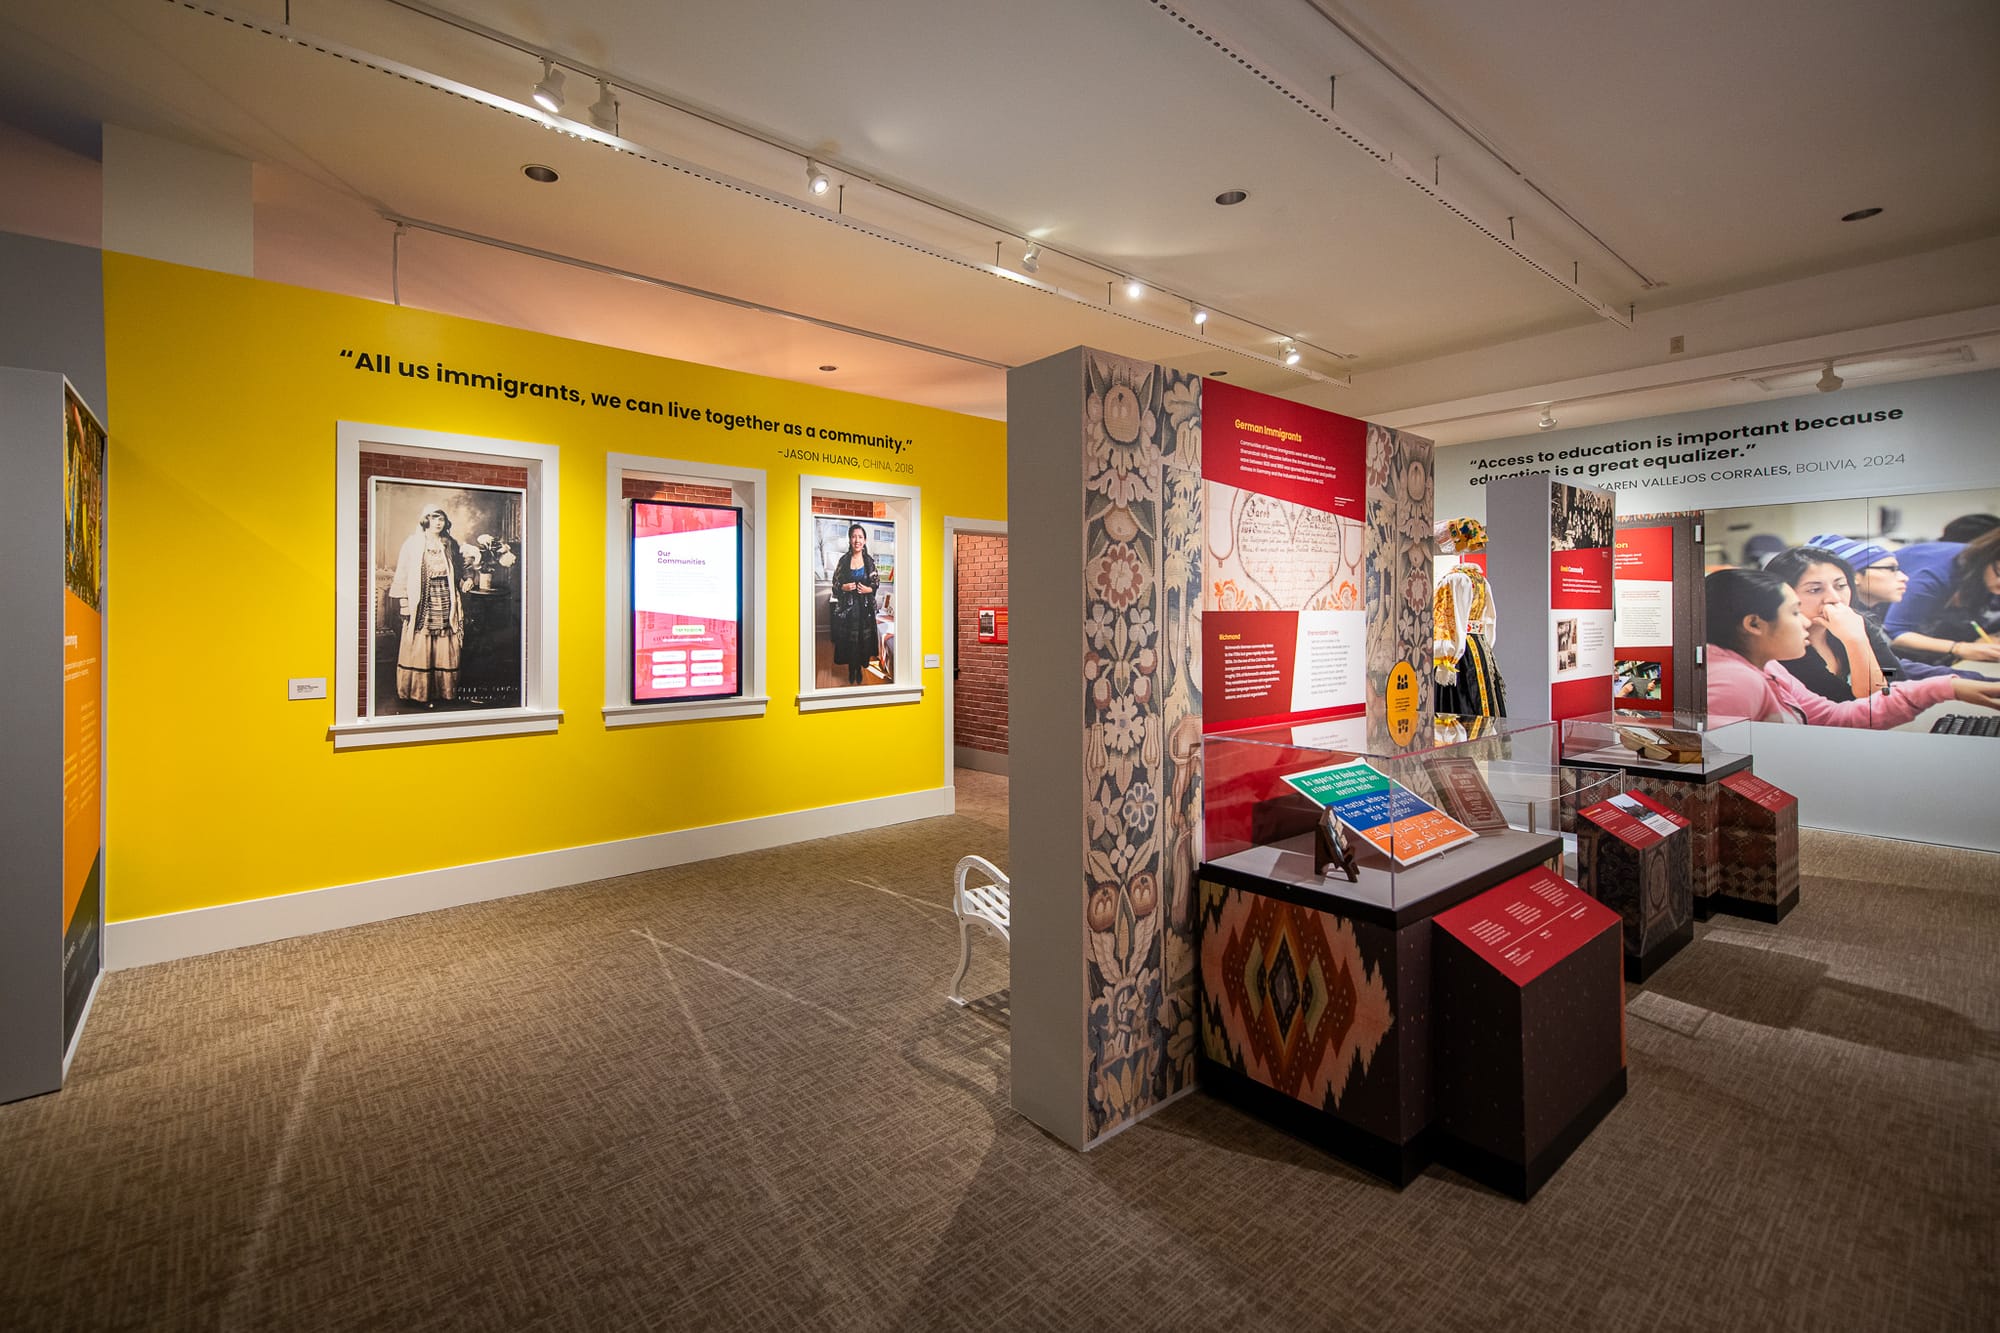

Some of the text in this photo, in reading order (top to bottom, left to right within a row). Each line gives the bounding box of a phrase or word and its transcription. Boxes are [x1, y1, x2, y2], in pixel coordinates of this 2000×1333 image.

[398, 361, 430, 379] us
[436, 363, 586, 407] immigrants,
[591, 392, 621, 408] we
[626, 399, 663, 416] can
[668, 402, 701, 420] live
[706, 408, 780, 432] together
[784, 424, 802, 436] as
[806, 428, 816, 438] a
[1235, 418, 1302, 442] German Immigrants
[1537, 451, 1555, 462] to
[1558, 439, 1652, 461] education
[1656, 435, 1673, 448] is
[1677, 420, 1789, 447] important
[1795, 408, 1904, 432] because
[822, 454, 861, 469] HUANG,
[894, 462, 914, 474] 2018
[1469, 468, 1551, 486] educati
[1555, 465, 1569, 477] is
[1573, 465, 1584, 475] a
[1588, 458, 1639, 477] great
[1641, 473, 1706, 488] VALLEJOS
[1710, 465, 1792, 481] CORRALES,
[1863, 453, 1905, 467] 2024
[657, 557, 706, 565] Communities
